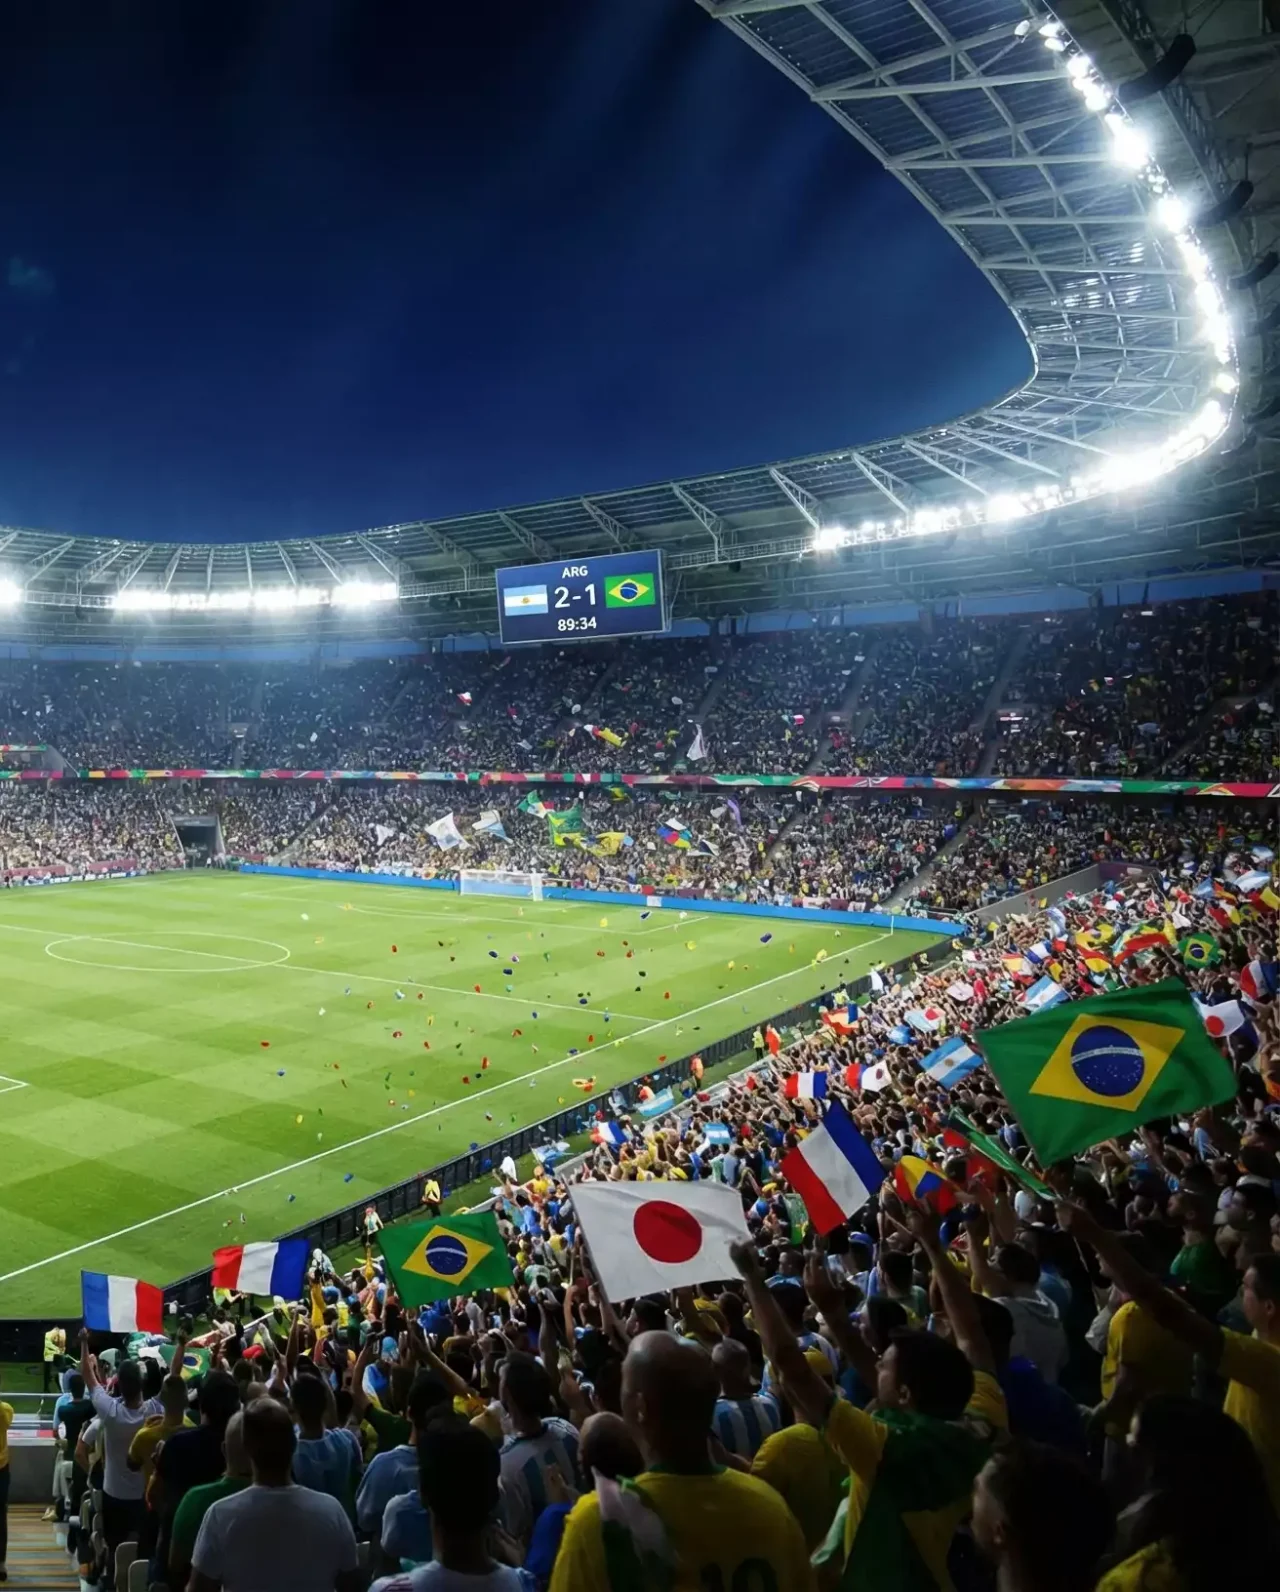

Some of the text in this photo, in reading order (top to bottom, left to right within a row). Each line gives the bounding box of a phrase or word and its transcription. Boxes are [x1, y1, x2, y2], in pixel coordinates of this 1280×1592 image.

[562, 566, 589, 578] ARG
[555, 584, 596, 608] 2-1
[558, 617, 597, 631] 89:34
